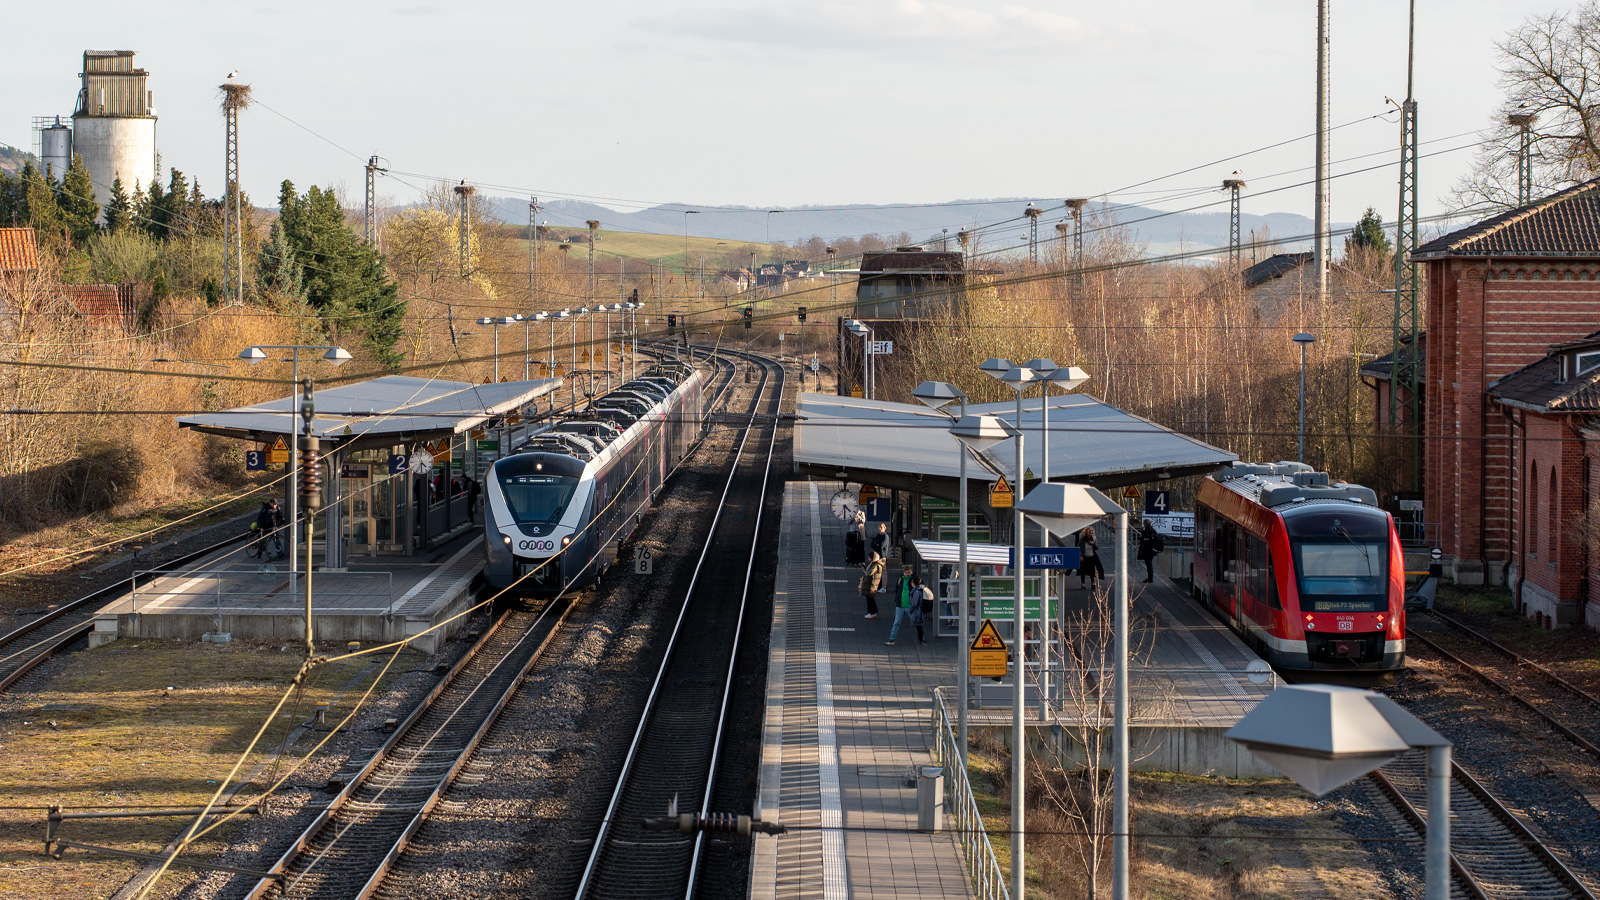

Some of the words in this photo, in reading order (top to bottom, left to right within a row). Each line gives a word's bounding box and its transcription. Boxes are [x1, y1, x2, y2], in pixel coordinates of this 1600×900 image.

[248, 452, 258, 466] 3
[396, 456, 406, 470] 2
[870, 498, 878, 516] 1
[1154, 492, 1166, 511] 4
[520, 541, 553, 550] enno
[637, 548, 651, 559] 76
[640, 560, 647, 572] 8
